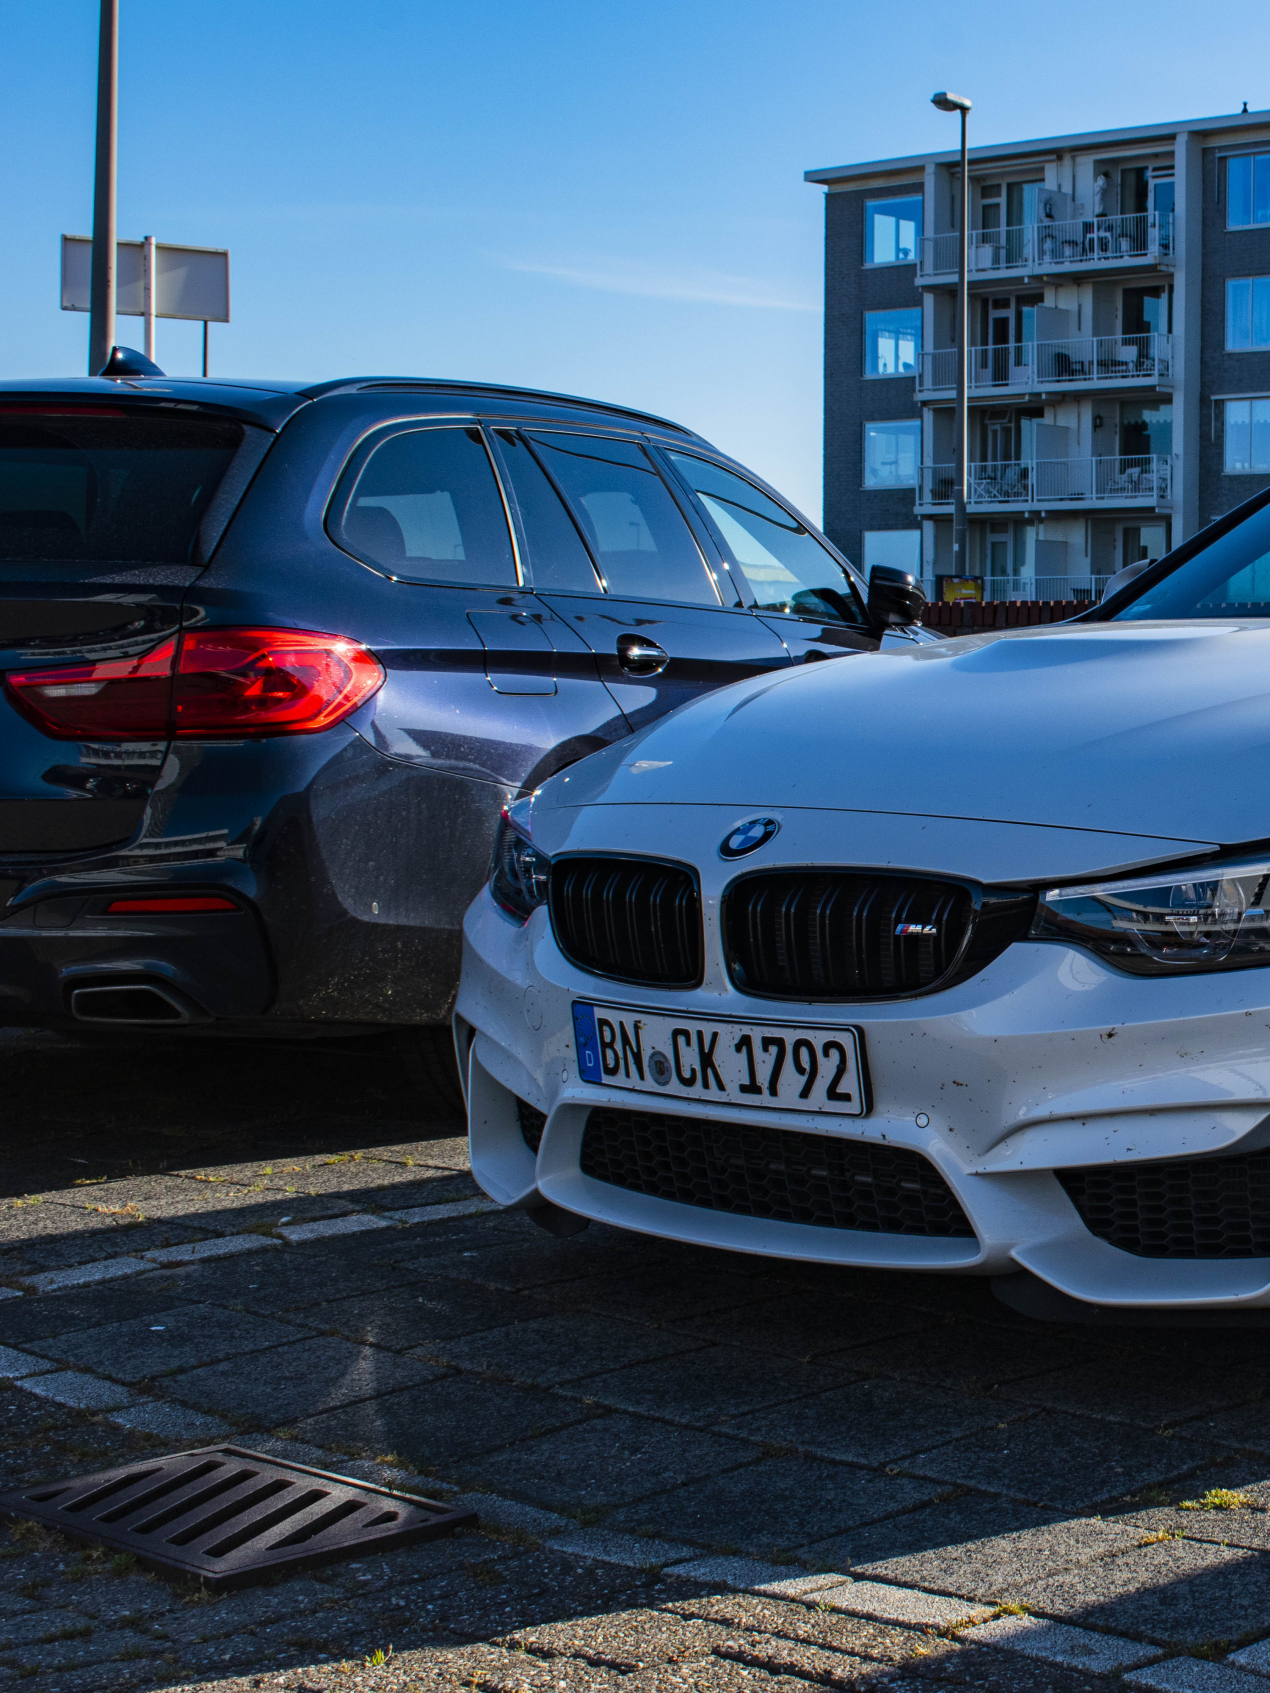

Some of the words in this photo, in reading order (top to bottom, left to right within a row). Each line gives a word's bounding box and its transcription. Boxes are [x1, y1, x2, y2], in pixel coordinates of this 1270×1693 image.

[906, 923, 938, 936] M4
[585, 1050, 594, 1067] D
[597, 1017, 646, 1081] BN
[672, 1027, 727, 1092] CK
[734, 1033, 852, 1102] 1792
